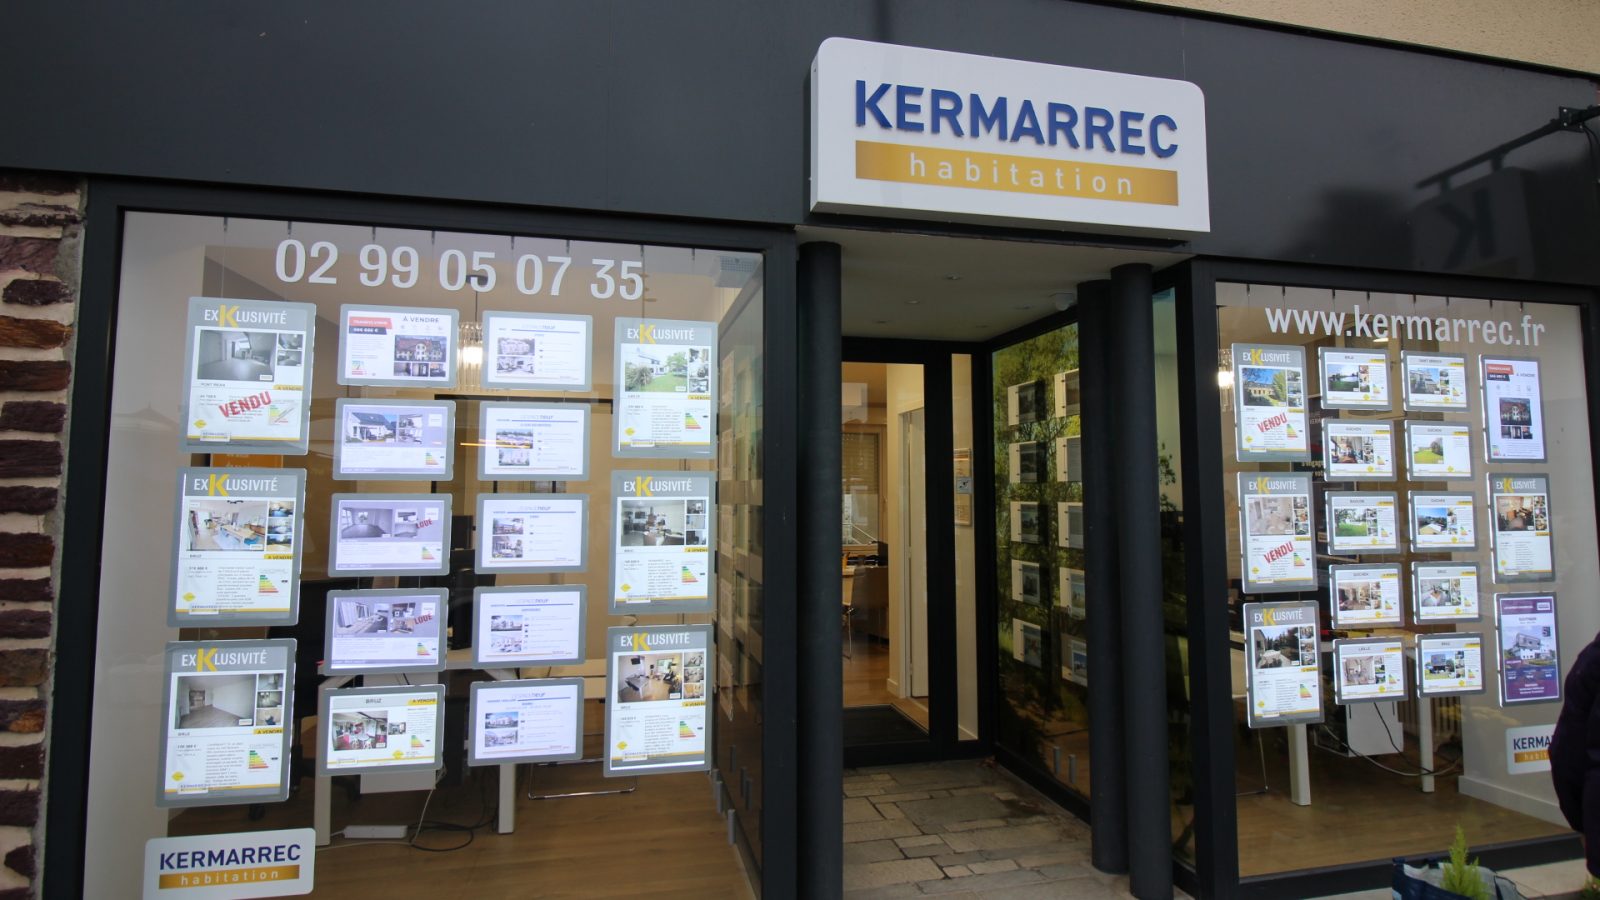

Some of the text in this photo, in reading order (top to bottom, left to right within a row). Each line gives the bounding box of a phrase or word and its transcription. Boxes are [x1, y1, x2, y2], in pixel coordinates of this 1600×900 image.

[855, 79, 1179, 159] KERMARREC
[909, 152, 1134, 196] habitation
[275, 239, 643, 300] 02 99 05 07 35
[204, 304, 288, 328] EXKLUSIVITÉ
[1265, 305, 1546, 346] www.kermarrec.fr
[627, 323, 695, 344] EXKLUSIVITÉ
[1242, 348, 1291, 366] EXKLUSIVITÉ
[219, 391, 272, 418] VENDU
[1257, 412, 1288, 433] VENDU
[194, 473, 278, 496] EXKLUSIVITÉ
[624, 476, 693, 496] EXKLUSIVITÉ
[1263, 541, 1295, 564] VENDU
[181, 647, 268, 672] EXKLUSIVITÉ
[1513, 736, 1553, 750] KERMA
[159, 843, 302, 871] KERMARREC
[181, 870, 280, 886] habitation
